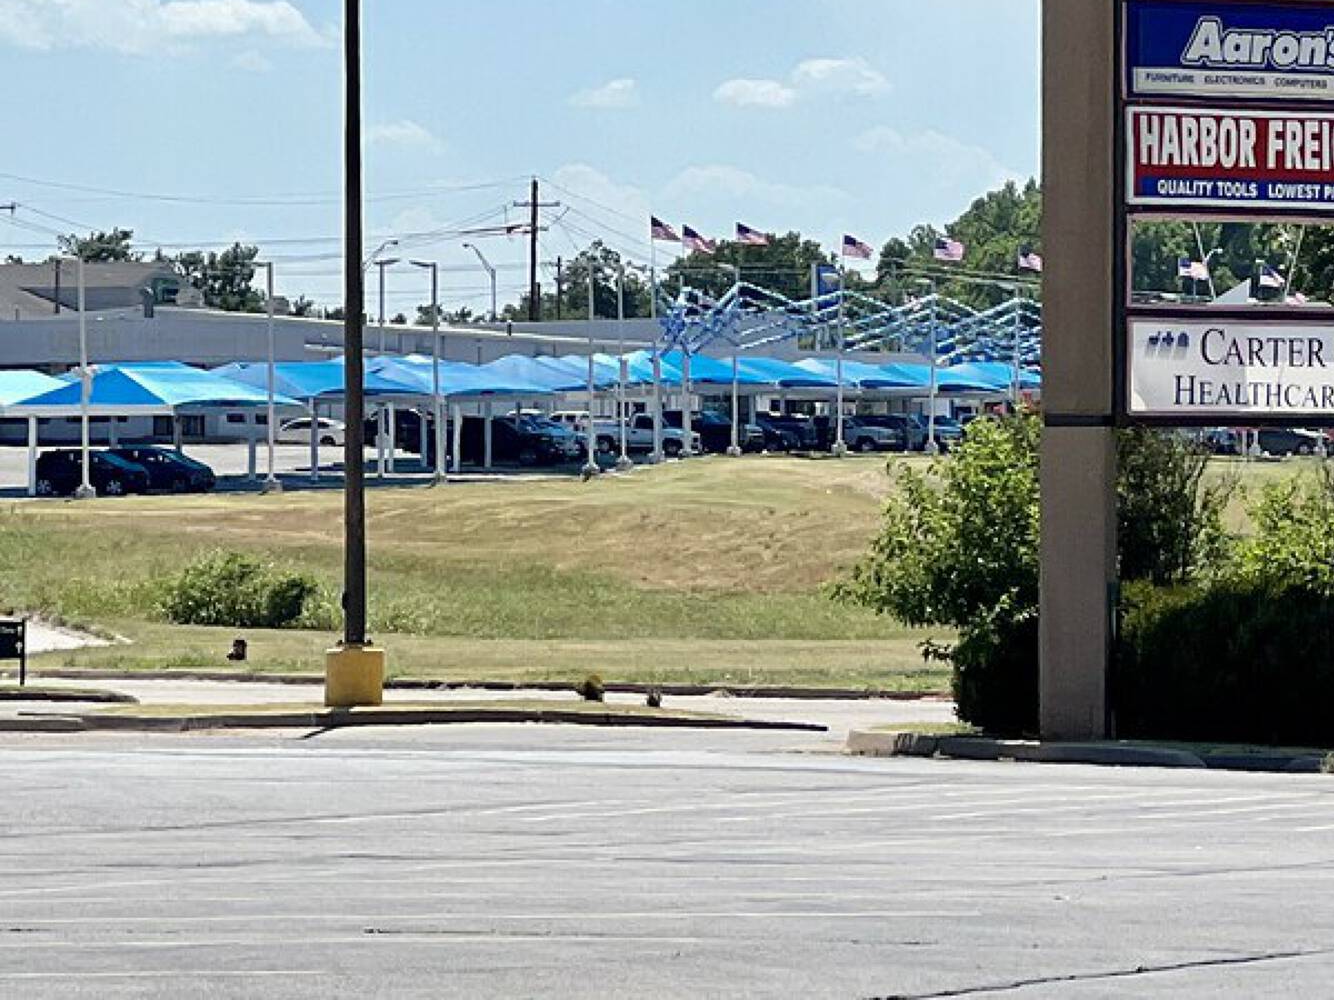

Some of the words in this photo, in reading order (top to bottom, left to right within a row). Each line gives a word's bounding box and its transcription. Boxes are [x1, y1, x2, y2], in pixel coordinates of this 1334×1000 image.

[1139, 114, 1257, 168] HARBOR
[1157, 179, 1214, 196] QUALITY
[1217, 181, 1258, 198] TOOLS
[1268, 183, 1321, 199] LOWEST
[1201, 328, 1326, 367] CARTER
